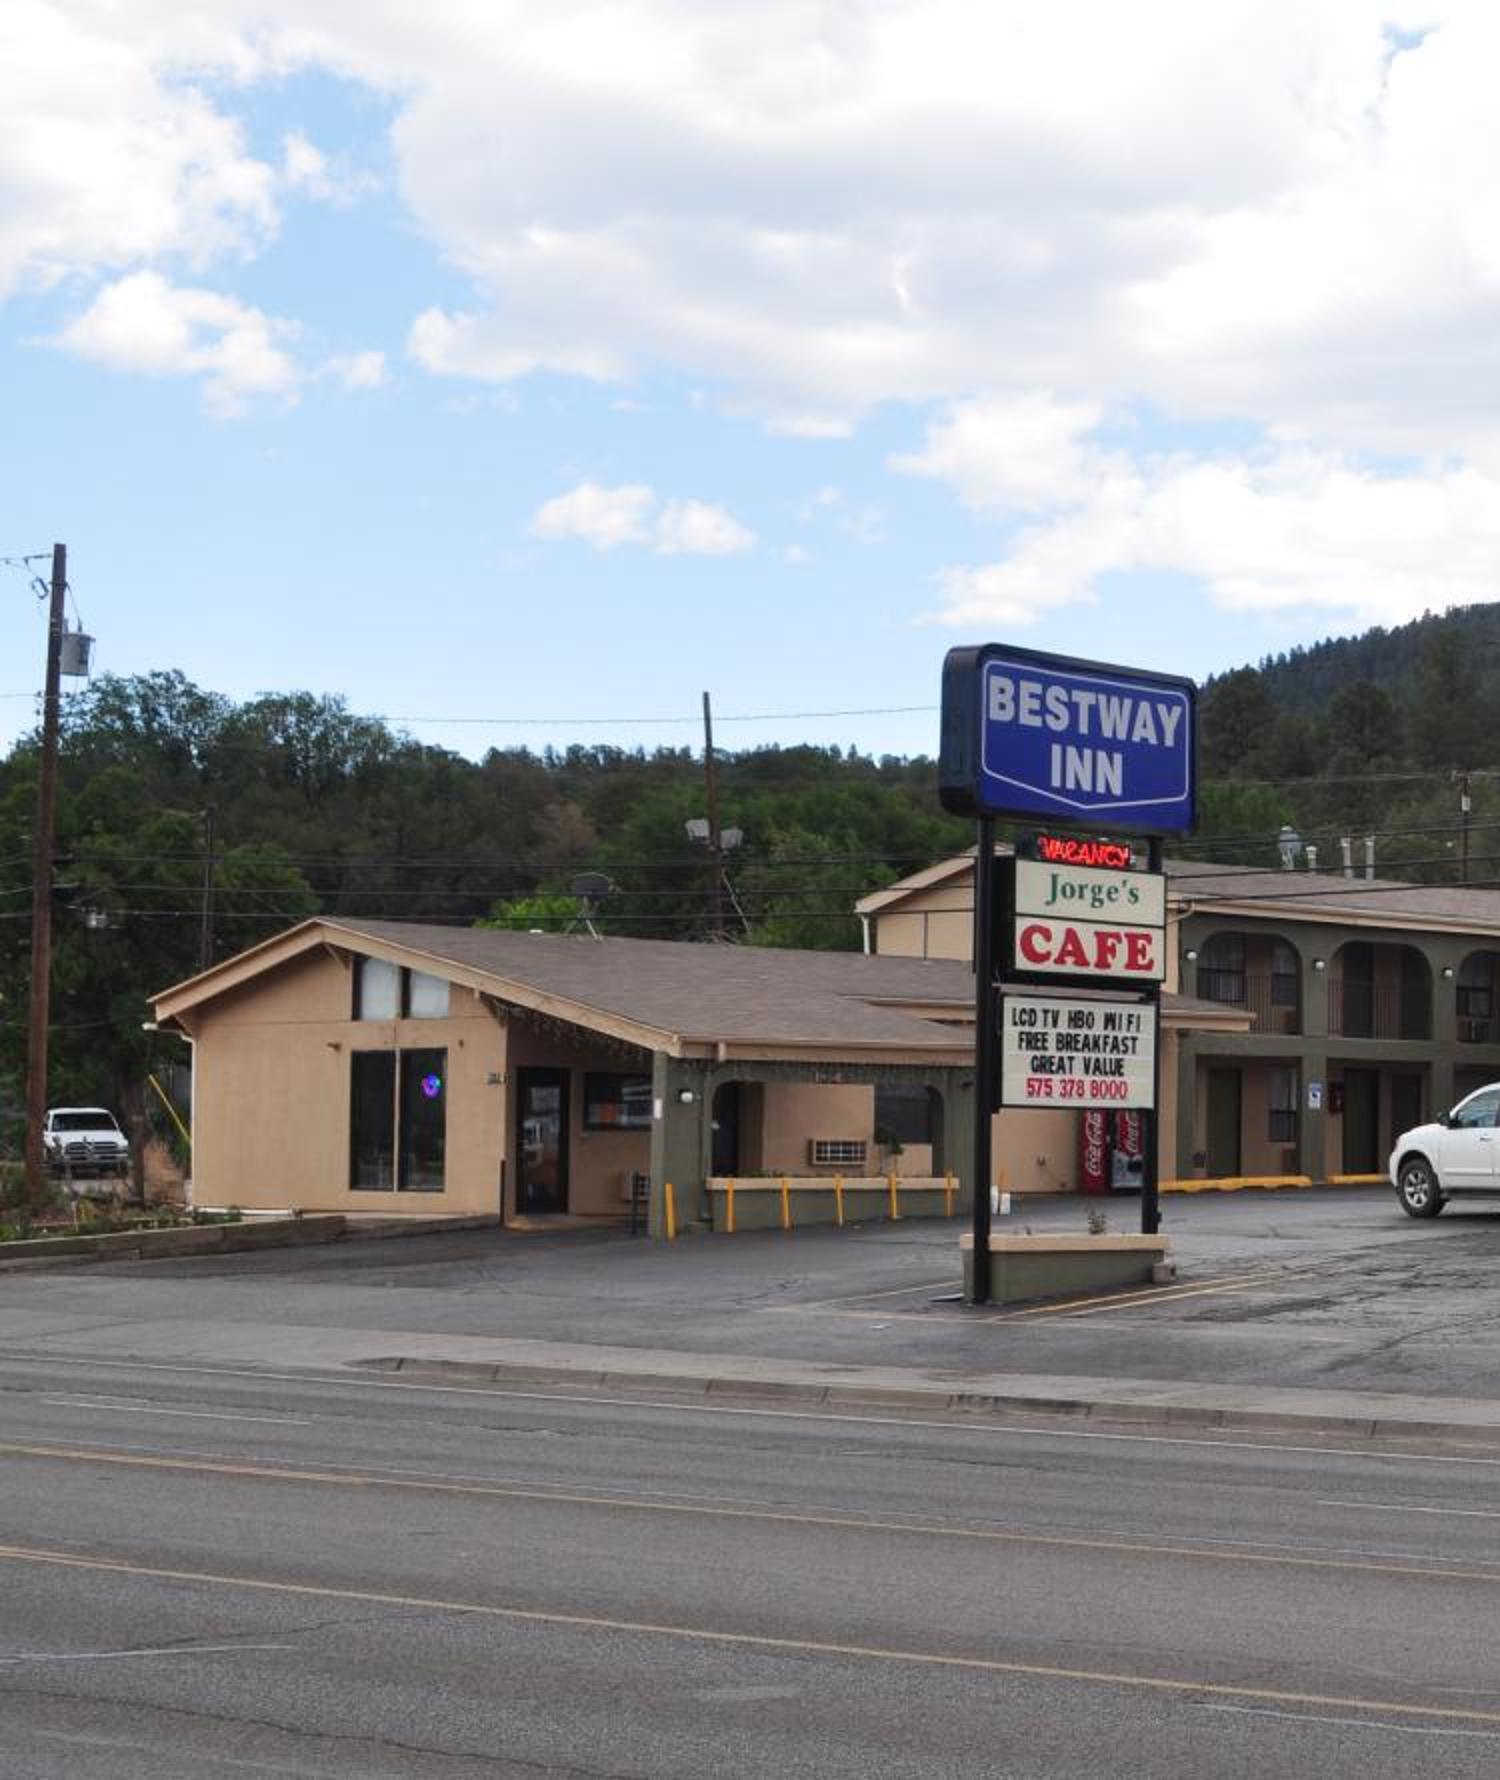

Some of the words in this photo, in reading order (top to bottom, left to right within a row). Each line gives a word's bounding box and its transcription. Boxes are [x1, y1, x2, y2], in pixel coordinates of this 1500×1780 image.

[989, 675, 1182, 747] BESTWAY
[1051, 744, 1123, 796] INN
[1043, 838, 1129, 866] VACANCY
[1045, 873, 1139, 908] Jorge's
[1020, 924, 1154, 971] CAFE
[1011, 1007, 1037, 1027] LCD
[1042, 1008, 1060, 1028] TV
[1067, 1010, 1095, 1029] HBO
[1018, 1031, 1049, 1051] FREE
[1056, 1033, 1139, 1055] BREAKFAST
[1031, 1055, 1075, 1075] GREAT
[1083, 1056, 1124, 1077] VALUE
[1026, 1078, 1053, 1098] 575
[1059, 1079, 1085, 1098] 378
